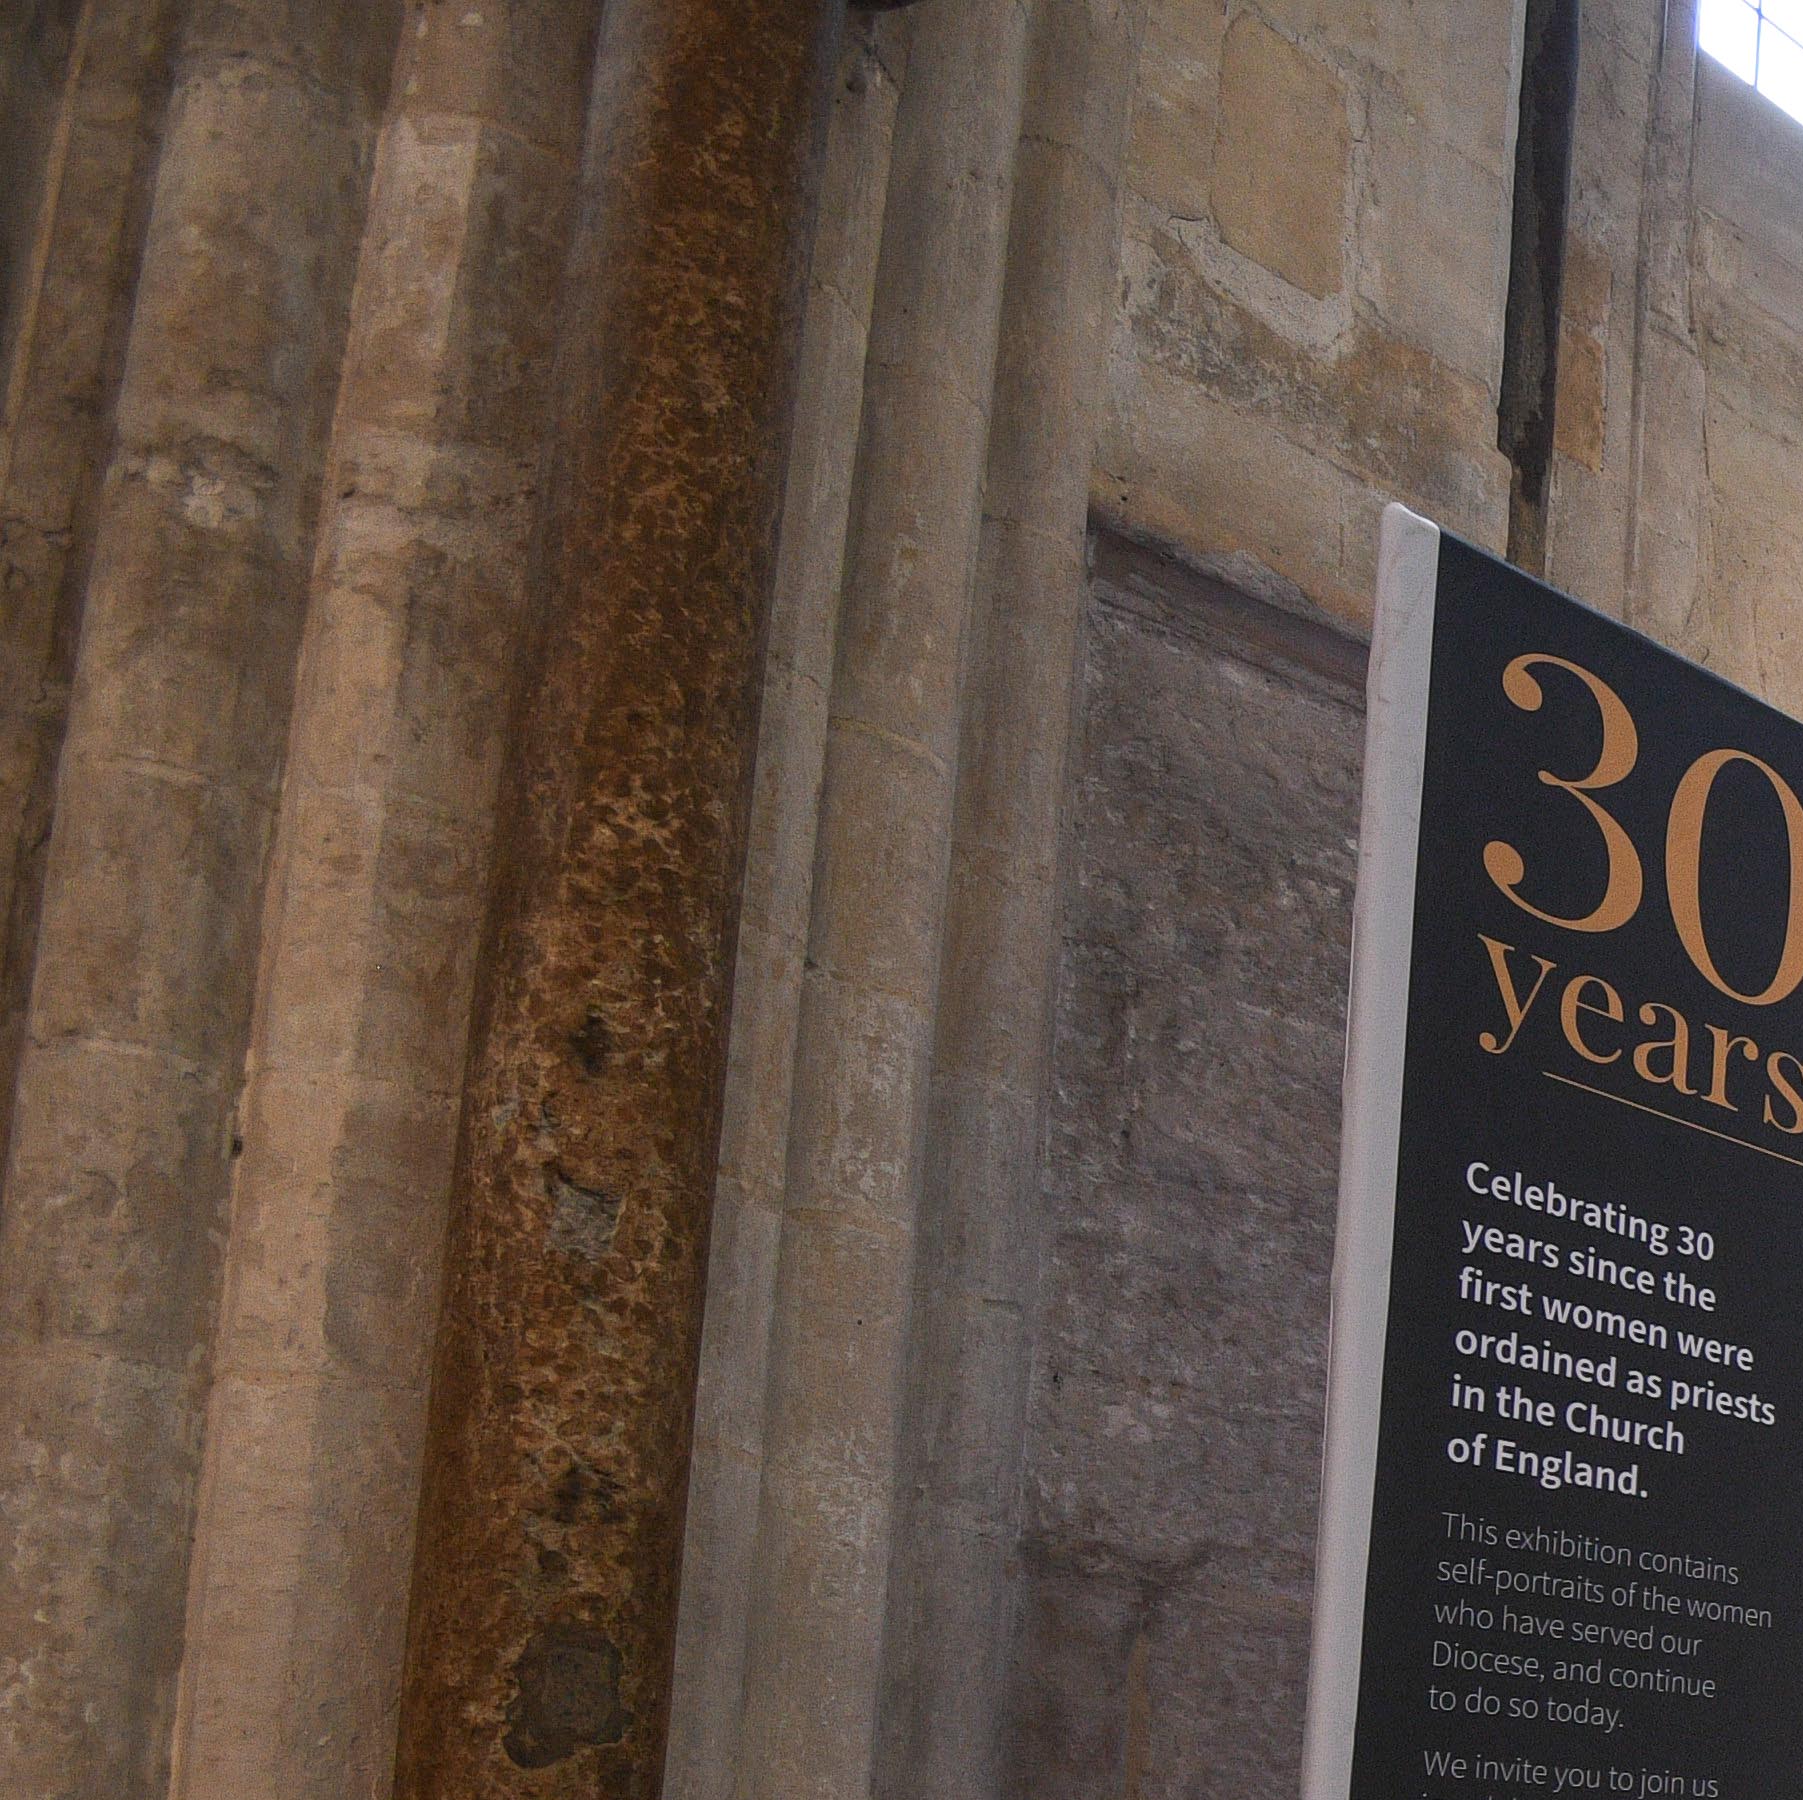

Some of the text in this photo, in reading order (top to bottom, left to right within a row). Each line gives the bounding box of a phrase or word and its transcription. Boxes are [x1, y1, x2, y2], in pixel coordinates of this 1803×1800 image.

[1466, 1162, 1714, 1261] Celebrating 30
[1461, 1220, 1716, 1311] years since the
[1459, 1267, 1754, 1371] first women were
[1455, 1328, 1776, 1426] ordained as priests
[1451, 1374, 1684, 1454] in the Church
[1448, 1433, 1649, 1498] of England.
[1442, 1512, 1739, 1585] This exhibition contains
[1435, 1601, 1702, 1656] who have served our
[1437, 1558, 1772, 1629] self-portraits of the women
[1432, 1641, 1716, 1698] Diocese, and continue
[1430, 1685, 1624, 1734] to do so today.
[1424, 1751, 1719, 1799] We invite you to join us
